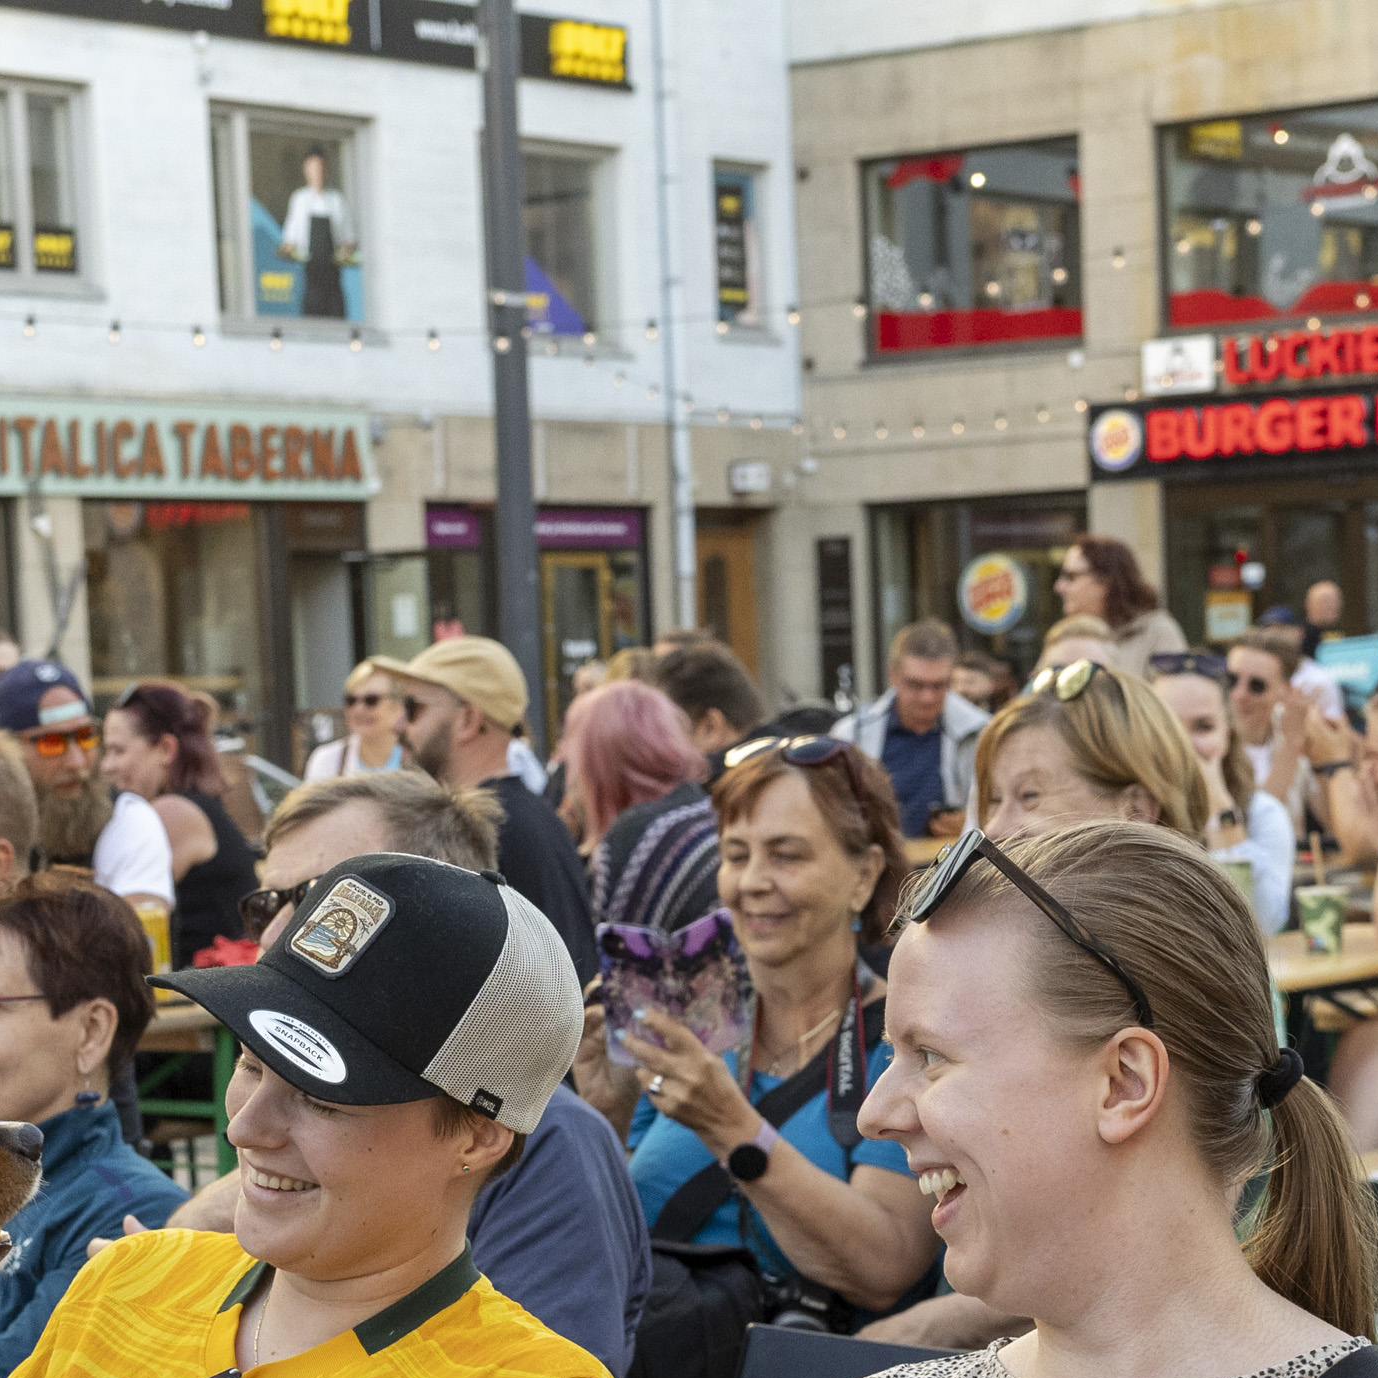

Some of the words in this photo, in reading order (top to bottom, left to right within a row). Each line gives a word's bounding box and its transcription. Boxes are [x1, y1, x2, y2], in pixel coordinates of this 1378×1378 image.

[172, 420, 364, 483] TABERNA
[1145, 394, 1368, 462] BURGER
[372, 897, 384, 907] PRO
[274, 1026, 324, 1062] SNAPBACK
[299, 1023, 331, 1049] AUTHENTIC
[838, 1030, 854, 1097] DIGITAL
